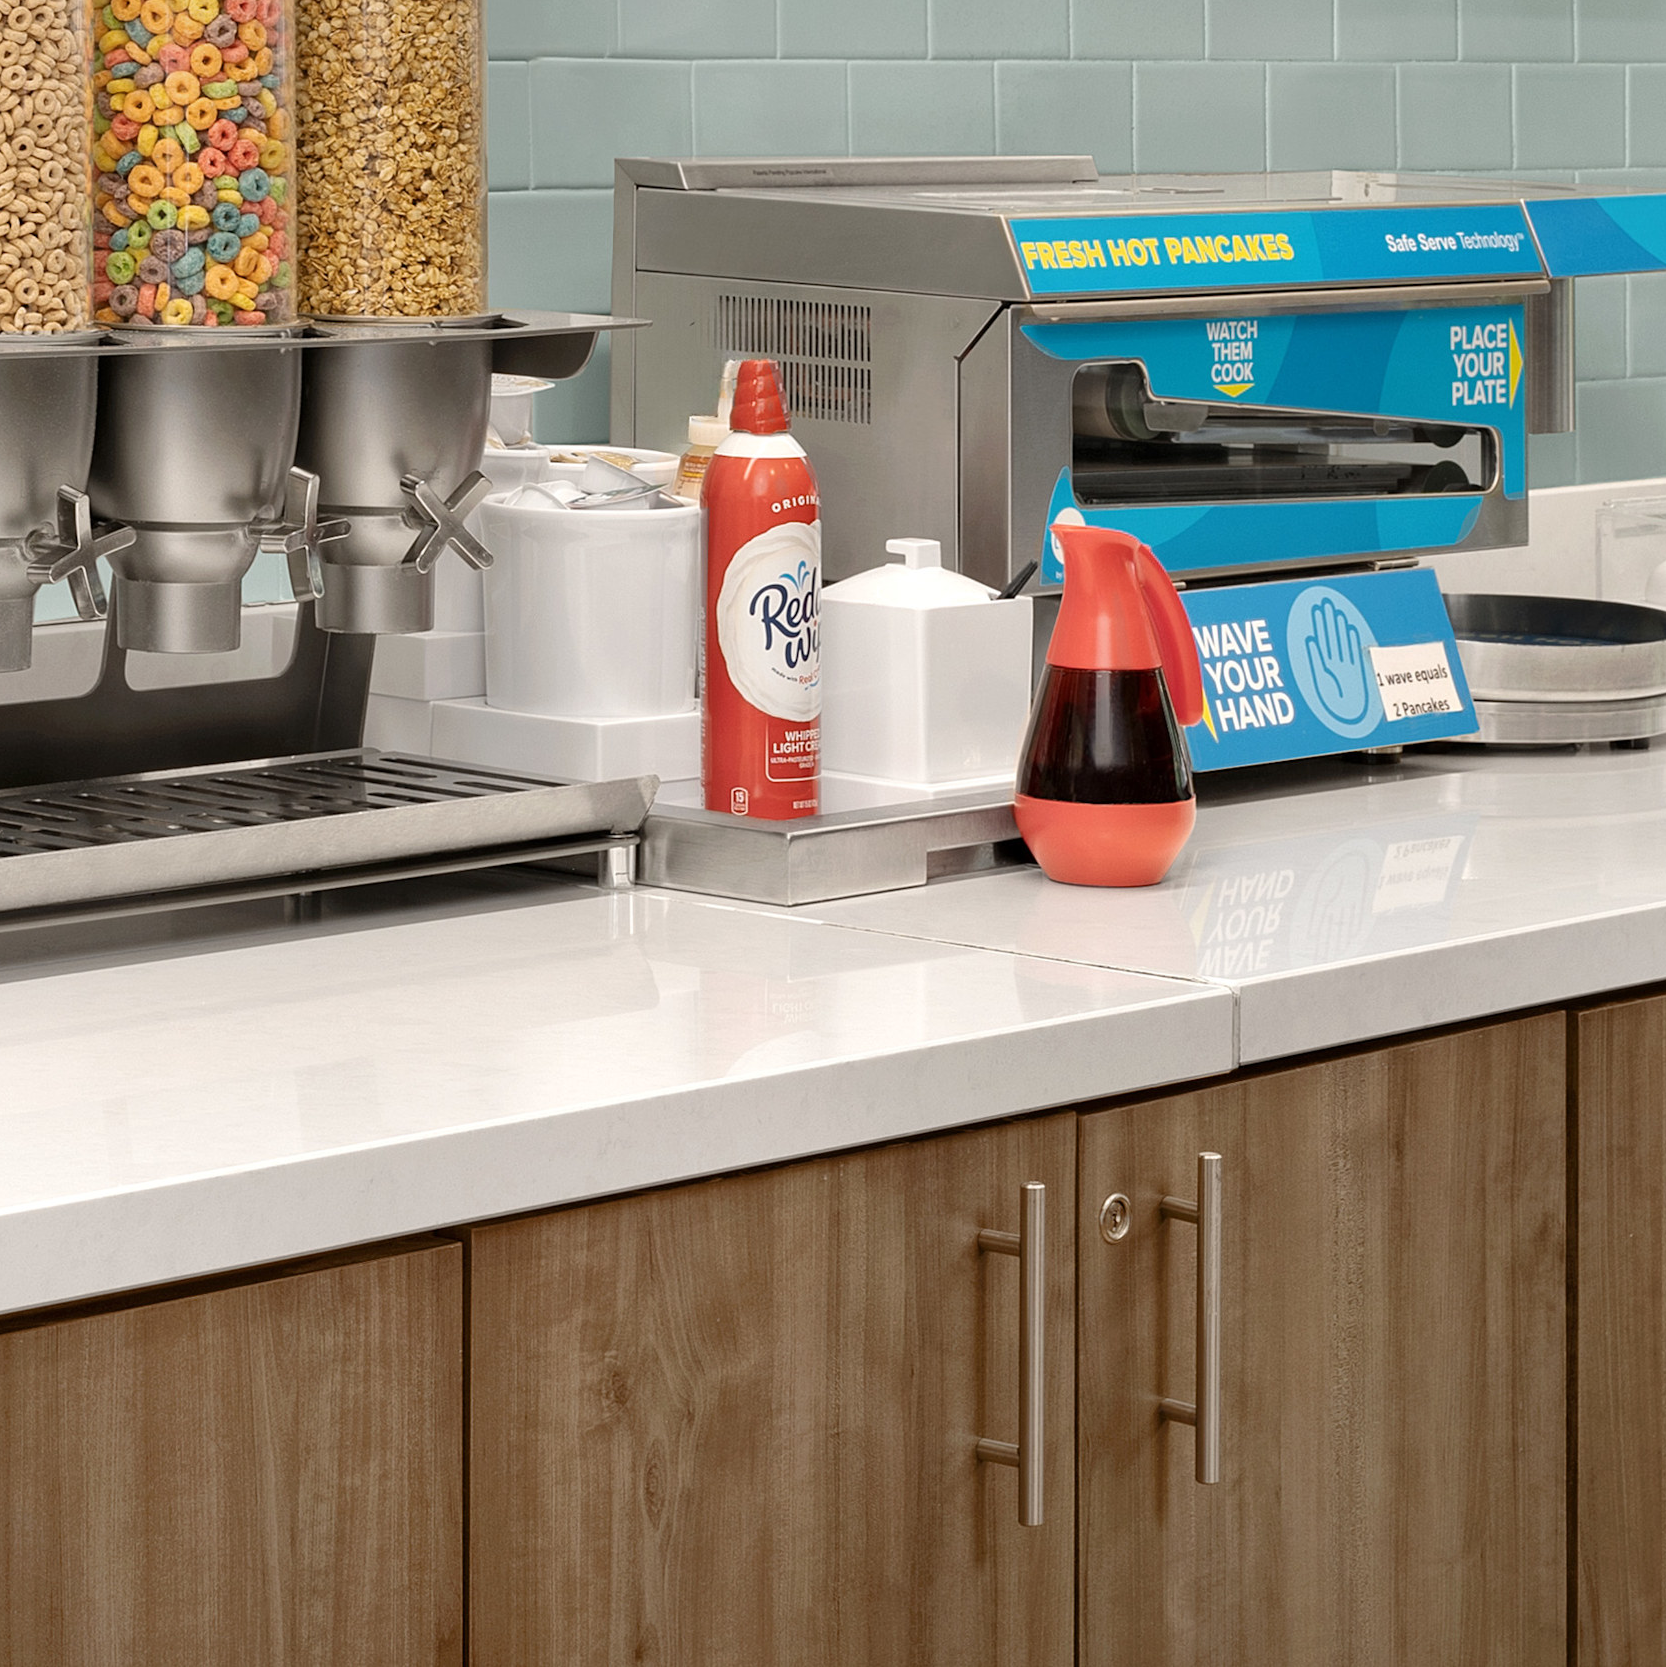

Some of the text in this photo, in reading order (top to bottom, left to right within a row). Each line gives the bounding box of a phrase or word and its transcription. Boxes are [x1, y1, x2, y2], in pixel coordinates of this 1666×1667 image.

[1020, 233, 1294, 271] FRESH HOT PANCAKES
[1385, 233, 1417, 253] Safe
[1417, 232, 1458, 251] Serve
[1206, 320, 1258, 342] WATCH
[1449, 324, 1507, 351] PLACE
[1211, 342, 1253, 363] THEM
[1210, 361, 1254, 383] COOK
[1453, 352, 1505, 379] YOUR
[1451, 378, 1507, 407] PLATE
[771, 494, 821, 513] ORIGINA
[1192, 619, 1273, 659] WAVE
[1204, 655, 1284, 695] YOUR
[1376, 664, 1448, 686] 1 wave equals
[1215, 692, 1295, 732] HAND
[1393, 698, 1450, 717] 2 Pancakes
[785, 728, 820, 741] WHIPPE
[773, 742, 804, 754] LIGHT
[735, 791, 744, 803] 15
